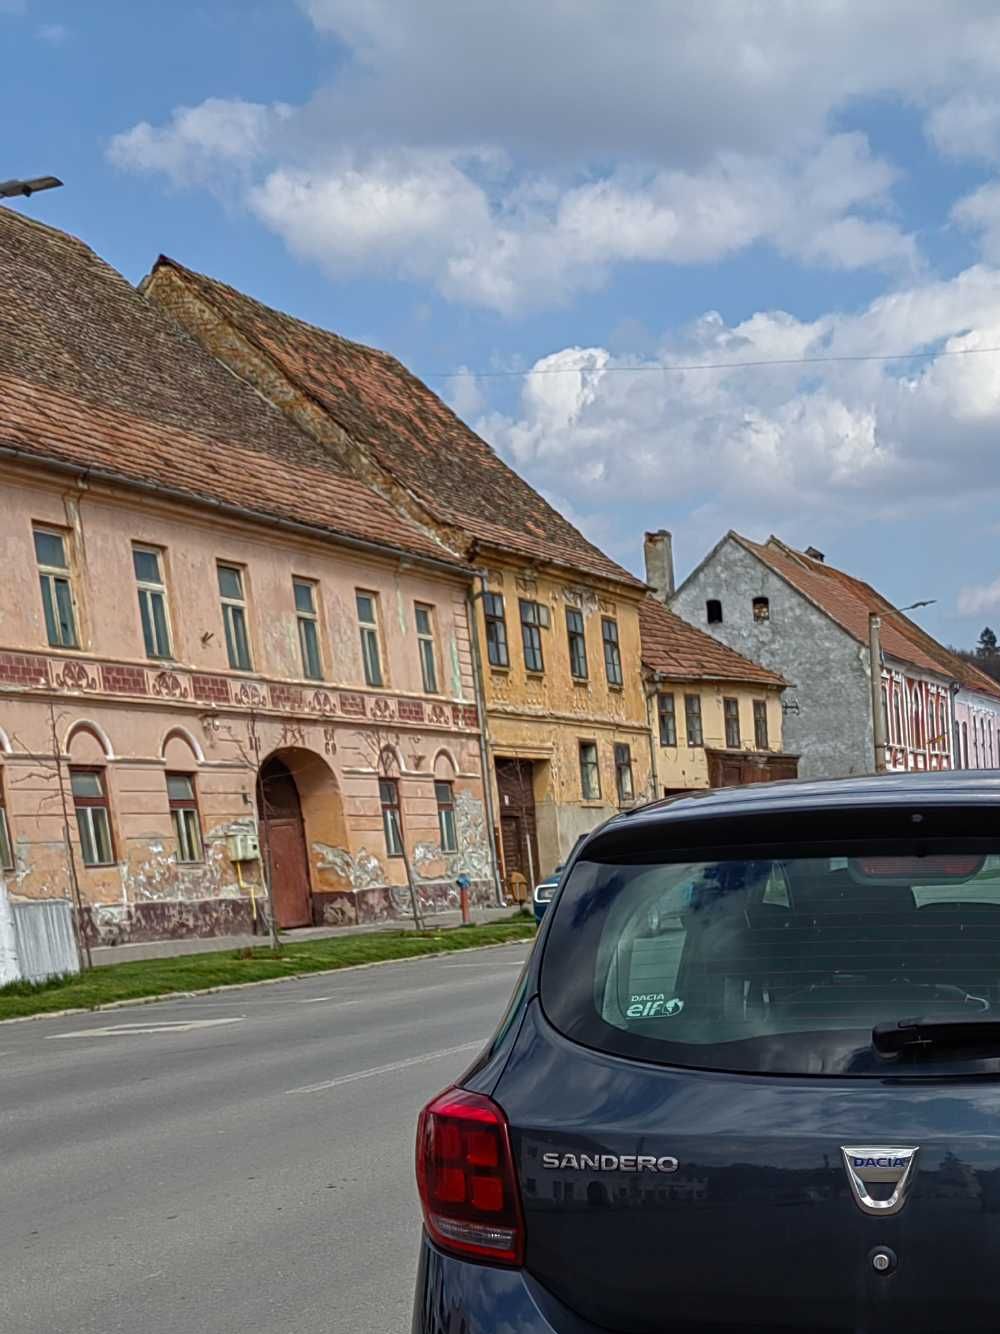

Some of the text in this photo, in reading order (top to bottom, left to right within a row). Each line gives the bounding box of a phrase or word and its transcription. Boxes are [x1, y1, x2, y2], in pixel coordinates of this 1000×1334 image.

[632, 994, 664, 1002] DACIA
[627, 1001, 664, 1017] elf
[543, 1153, 679, 1173] SANDERO
[853, 1156, 906, 1169] DACIA
